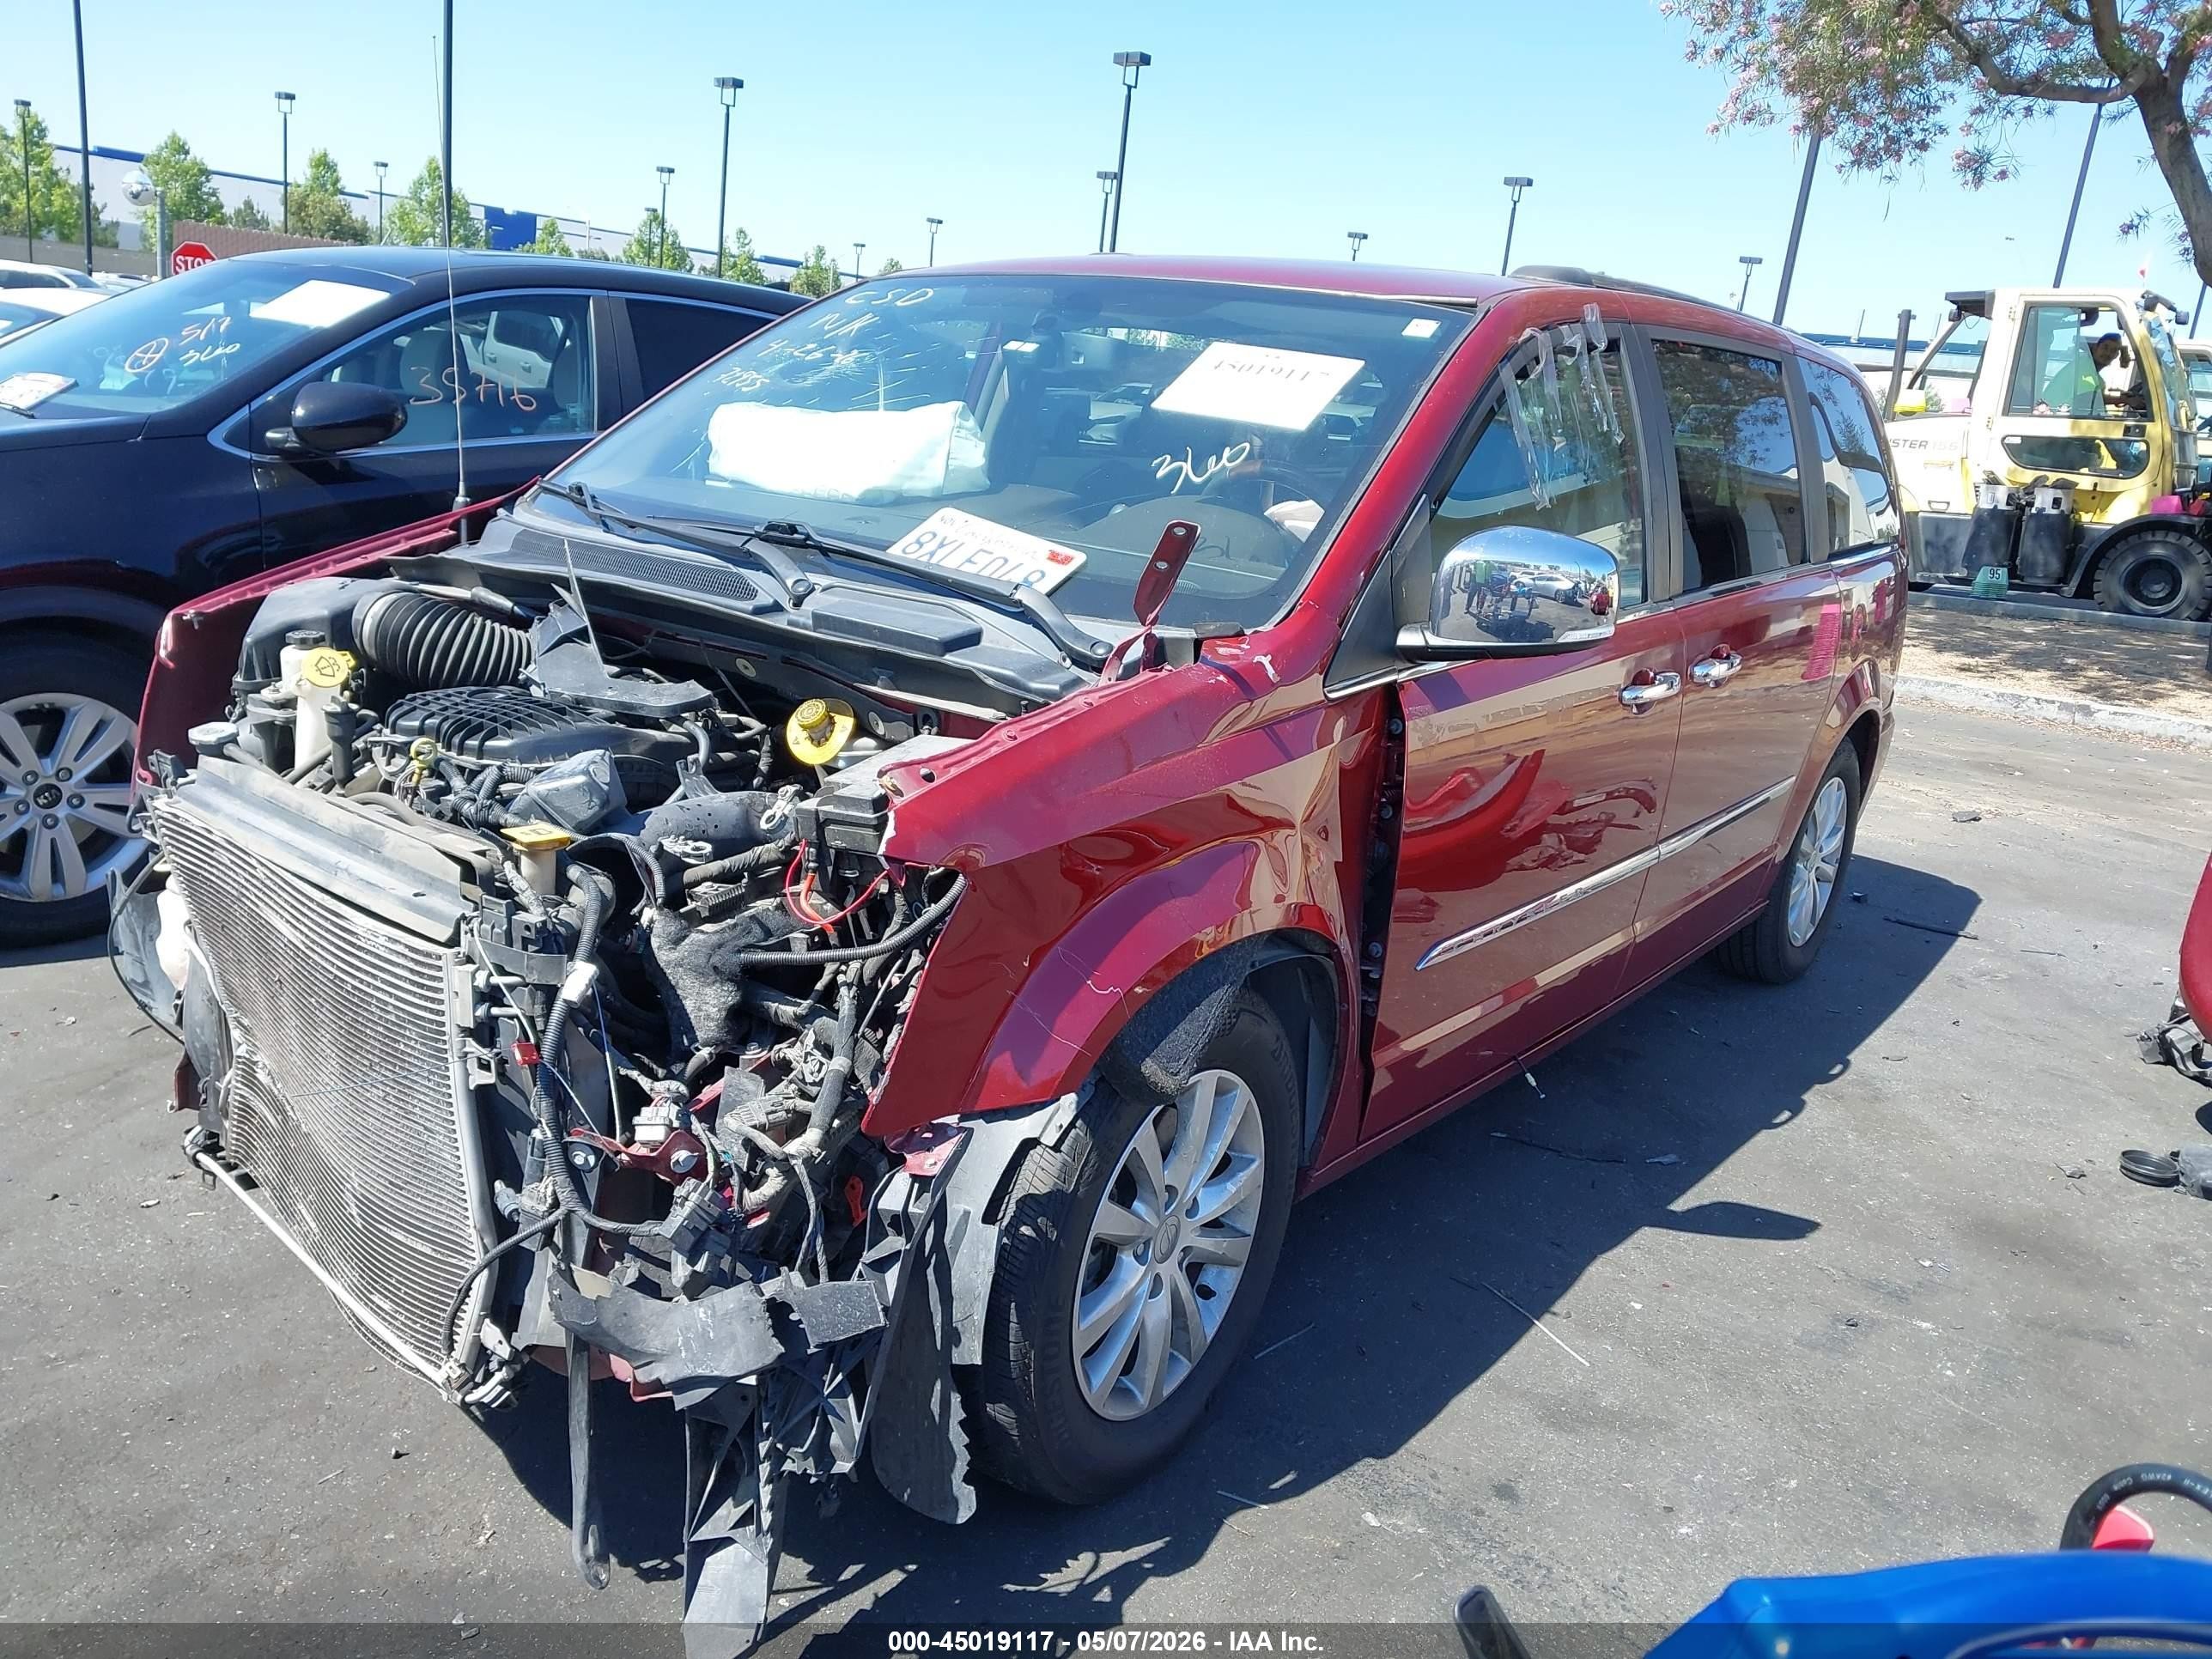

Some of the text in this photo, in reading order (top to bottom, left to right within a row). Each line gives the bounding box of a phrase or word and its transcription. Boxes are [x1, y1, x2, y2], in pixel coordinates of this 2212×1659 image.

[175, 255, 213, 273] STO
[1889, 439, 1929, 449] STER
[1989, 568, 2001, 580] 95
[37, 789, 61, 805] KIA
